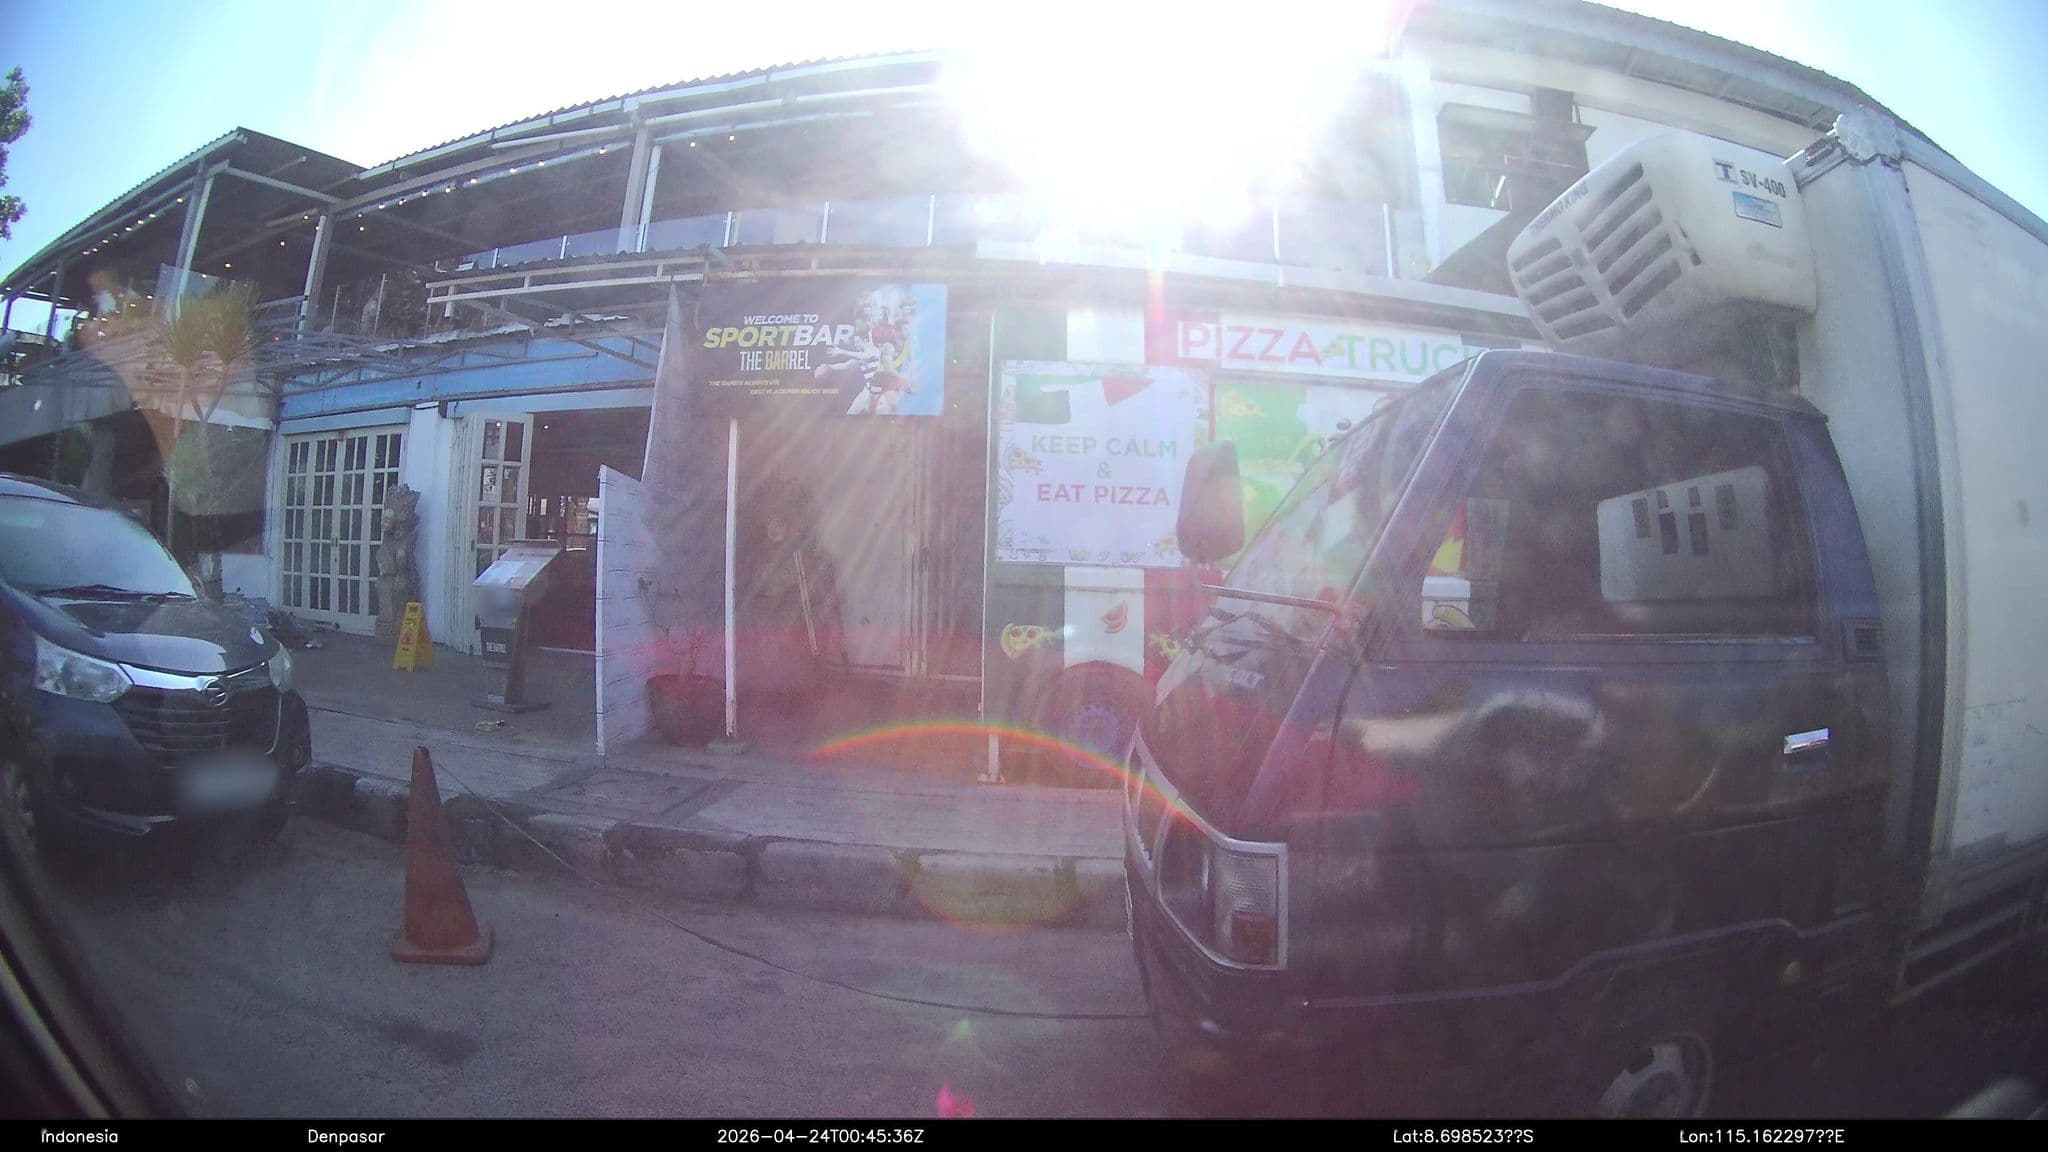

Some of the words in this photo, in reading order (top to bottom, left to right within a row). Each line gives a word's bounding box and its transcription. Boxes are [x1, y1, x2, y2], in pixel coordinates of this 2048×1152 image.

[1740, 168, 1786, 199] SV-400
[743, 314, 801, 326] WELCOME
[803, 313, 819, 324] TO
[703, 324, 855, 349] SPORTBAR
[1181, 324, 1324, 367] PIZZA
[739, 351, 762, 371] THE
[765, 350, 812, 370] BARREL
[1031, 434, 1097, 455] KEEP
[1106, 437, 1177, 458] CALM
[1096, 461, 1113, 479] &
[1036, 483, 1085, 502] EAT
[1094, 485, 1171, 506] PIZZA
